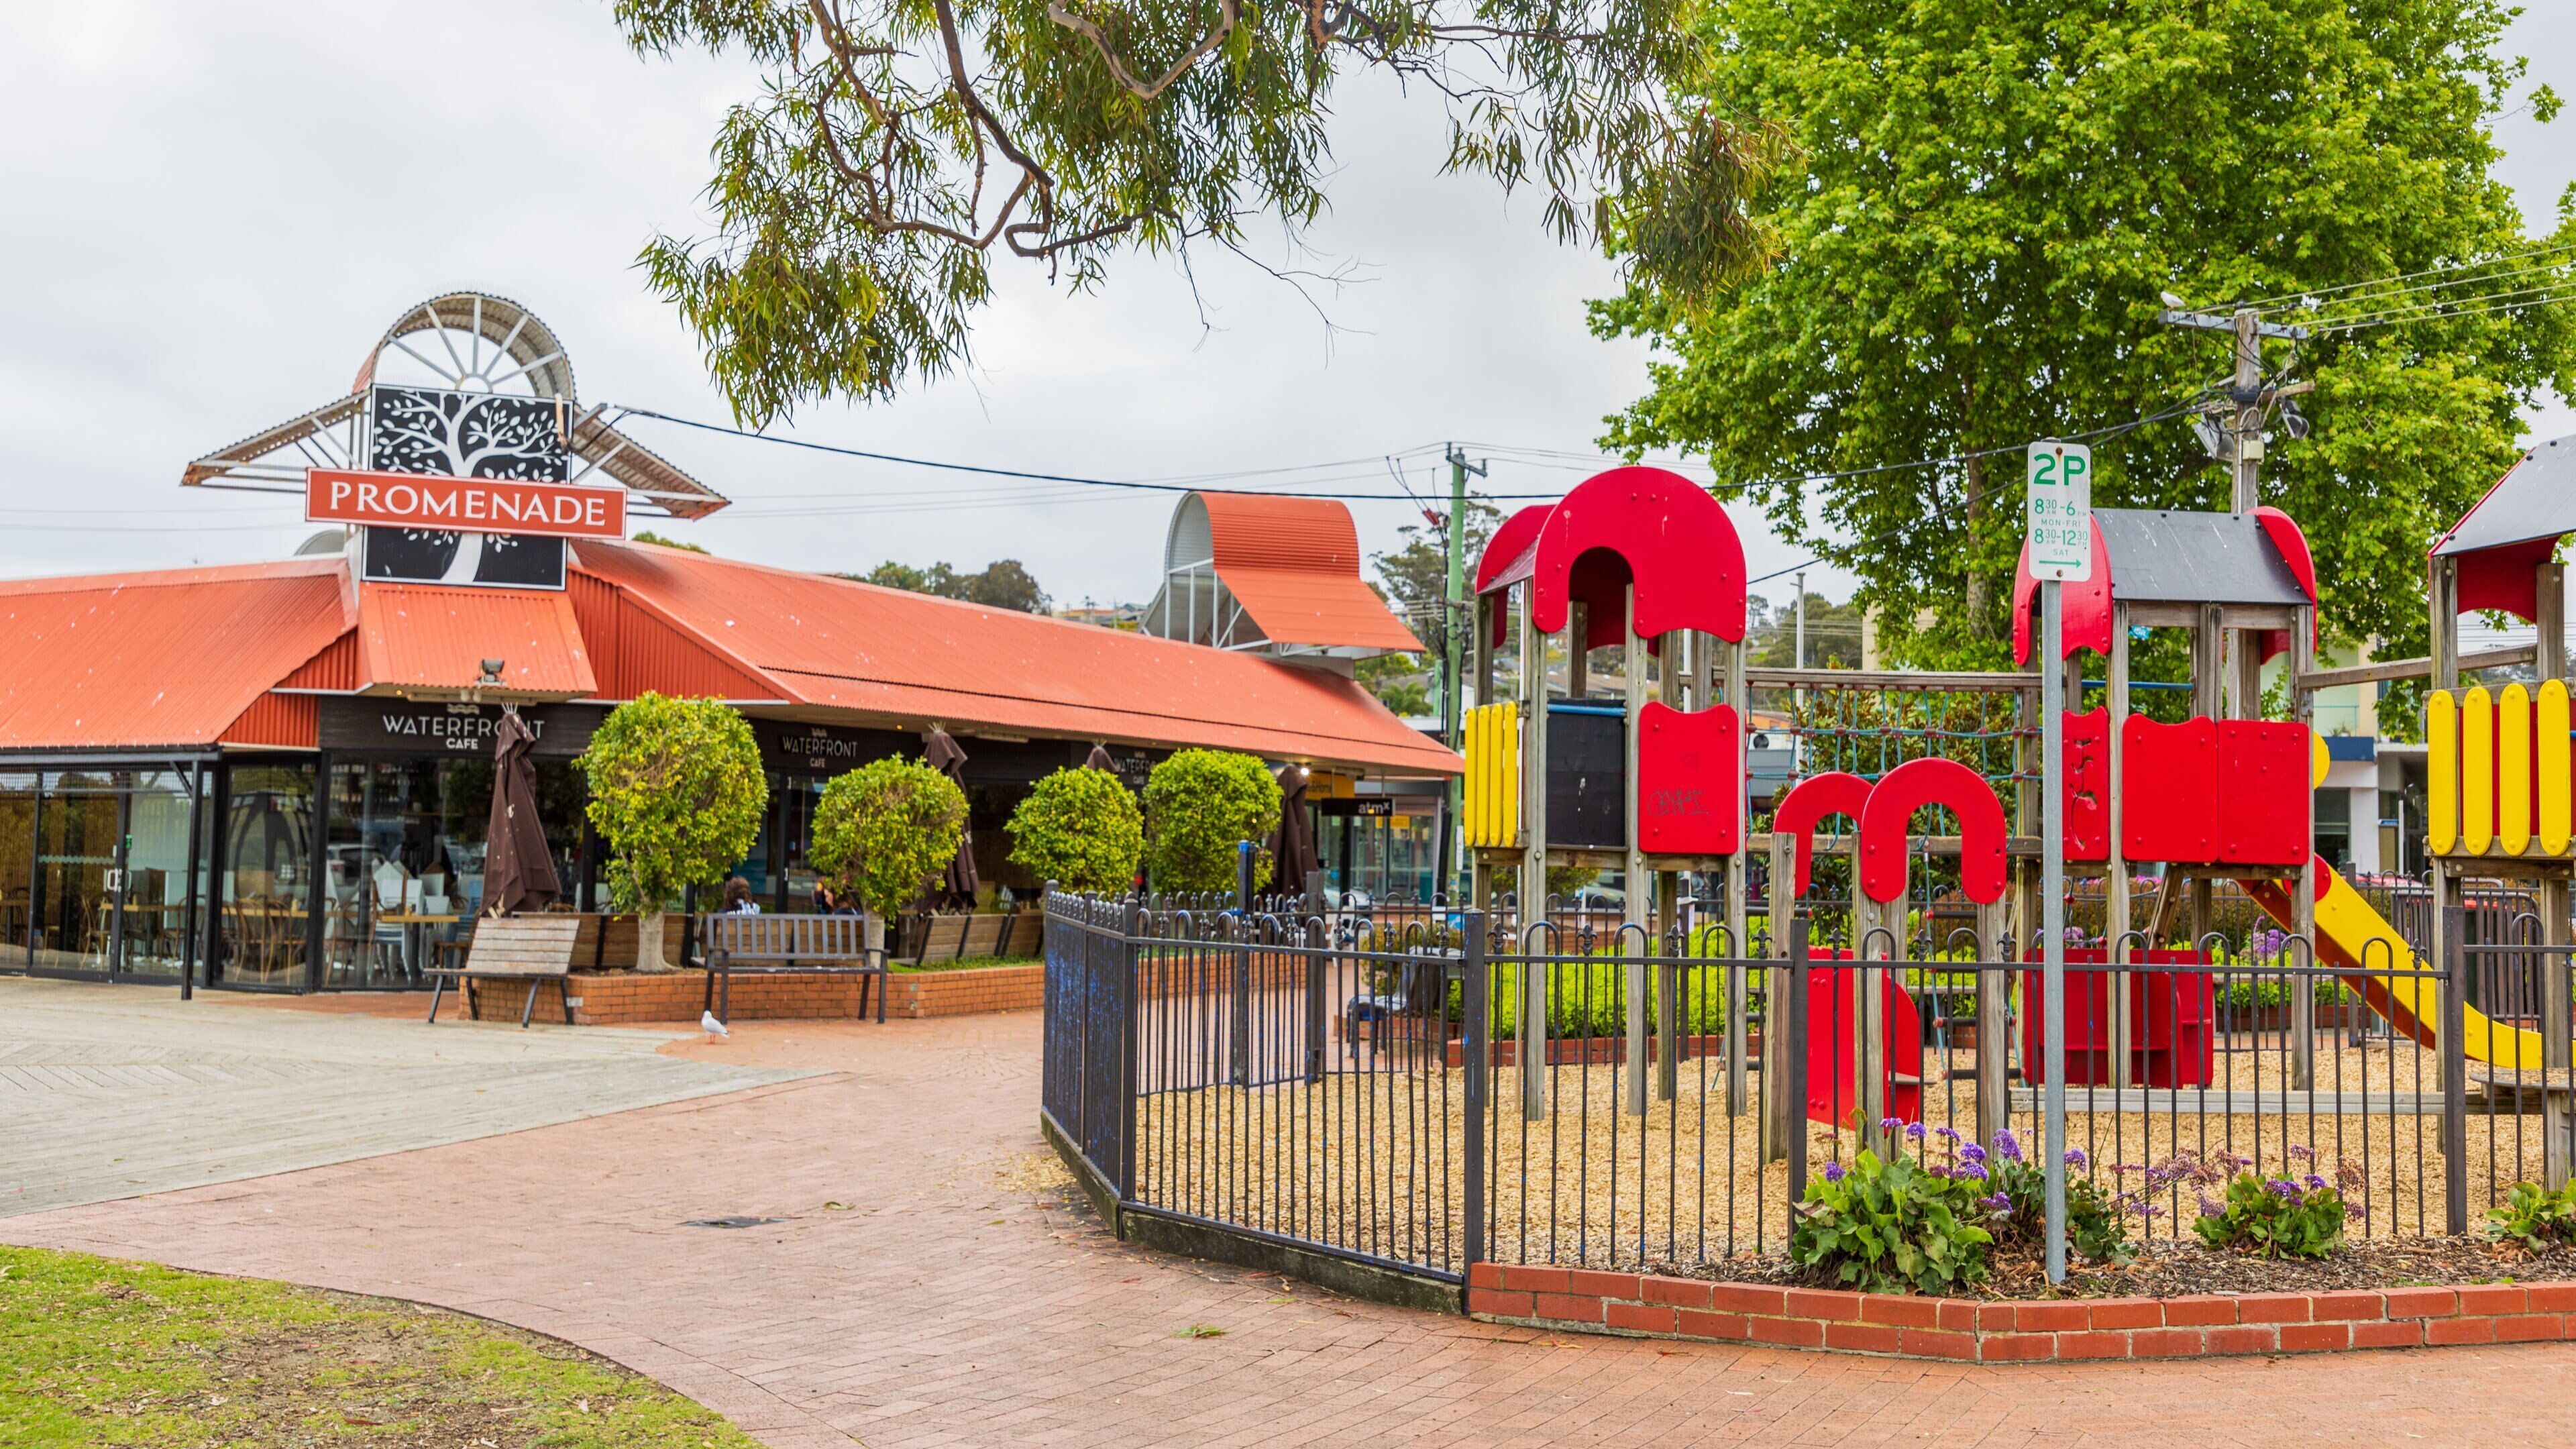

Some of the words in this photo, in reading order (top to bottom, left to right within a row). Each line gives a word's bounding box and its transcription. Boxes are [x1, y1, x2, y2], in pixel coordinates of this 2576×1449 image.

[2033, 453, 2086, 486] 2P
[330, 481, 606, 527] PROMENADE
[2053, 548, 2069, 556] SAT
[445, 738, 478, 750] CAFE
[782, 735, 858, 759] WATERFRONT
[810, 757, 826, 768] CAFE
